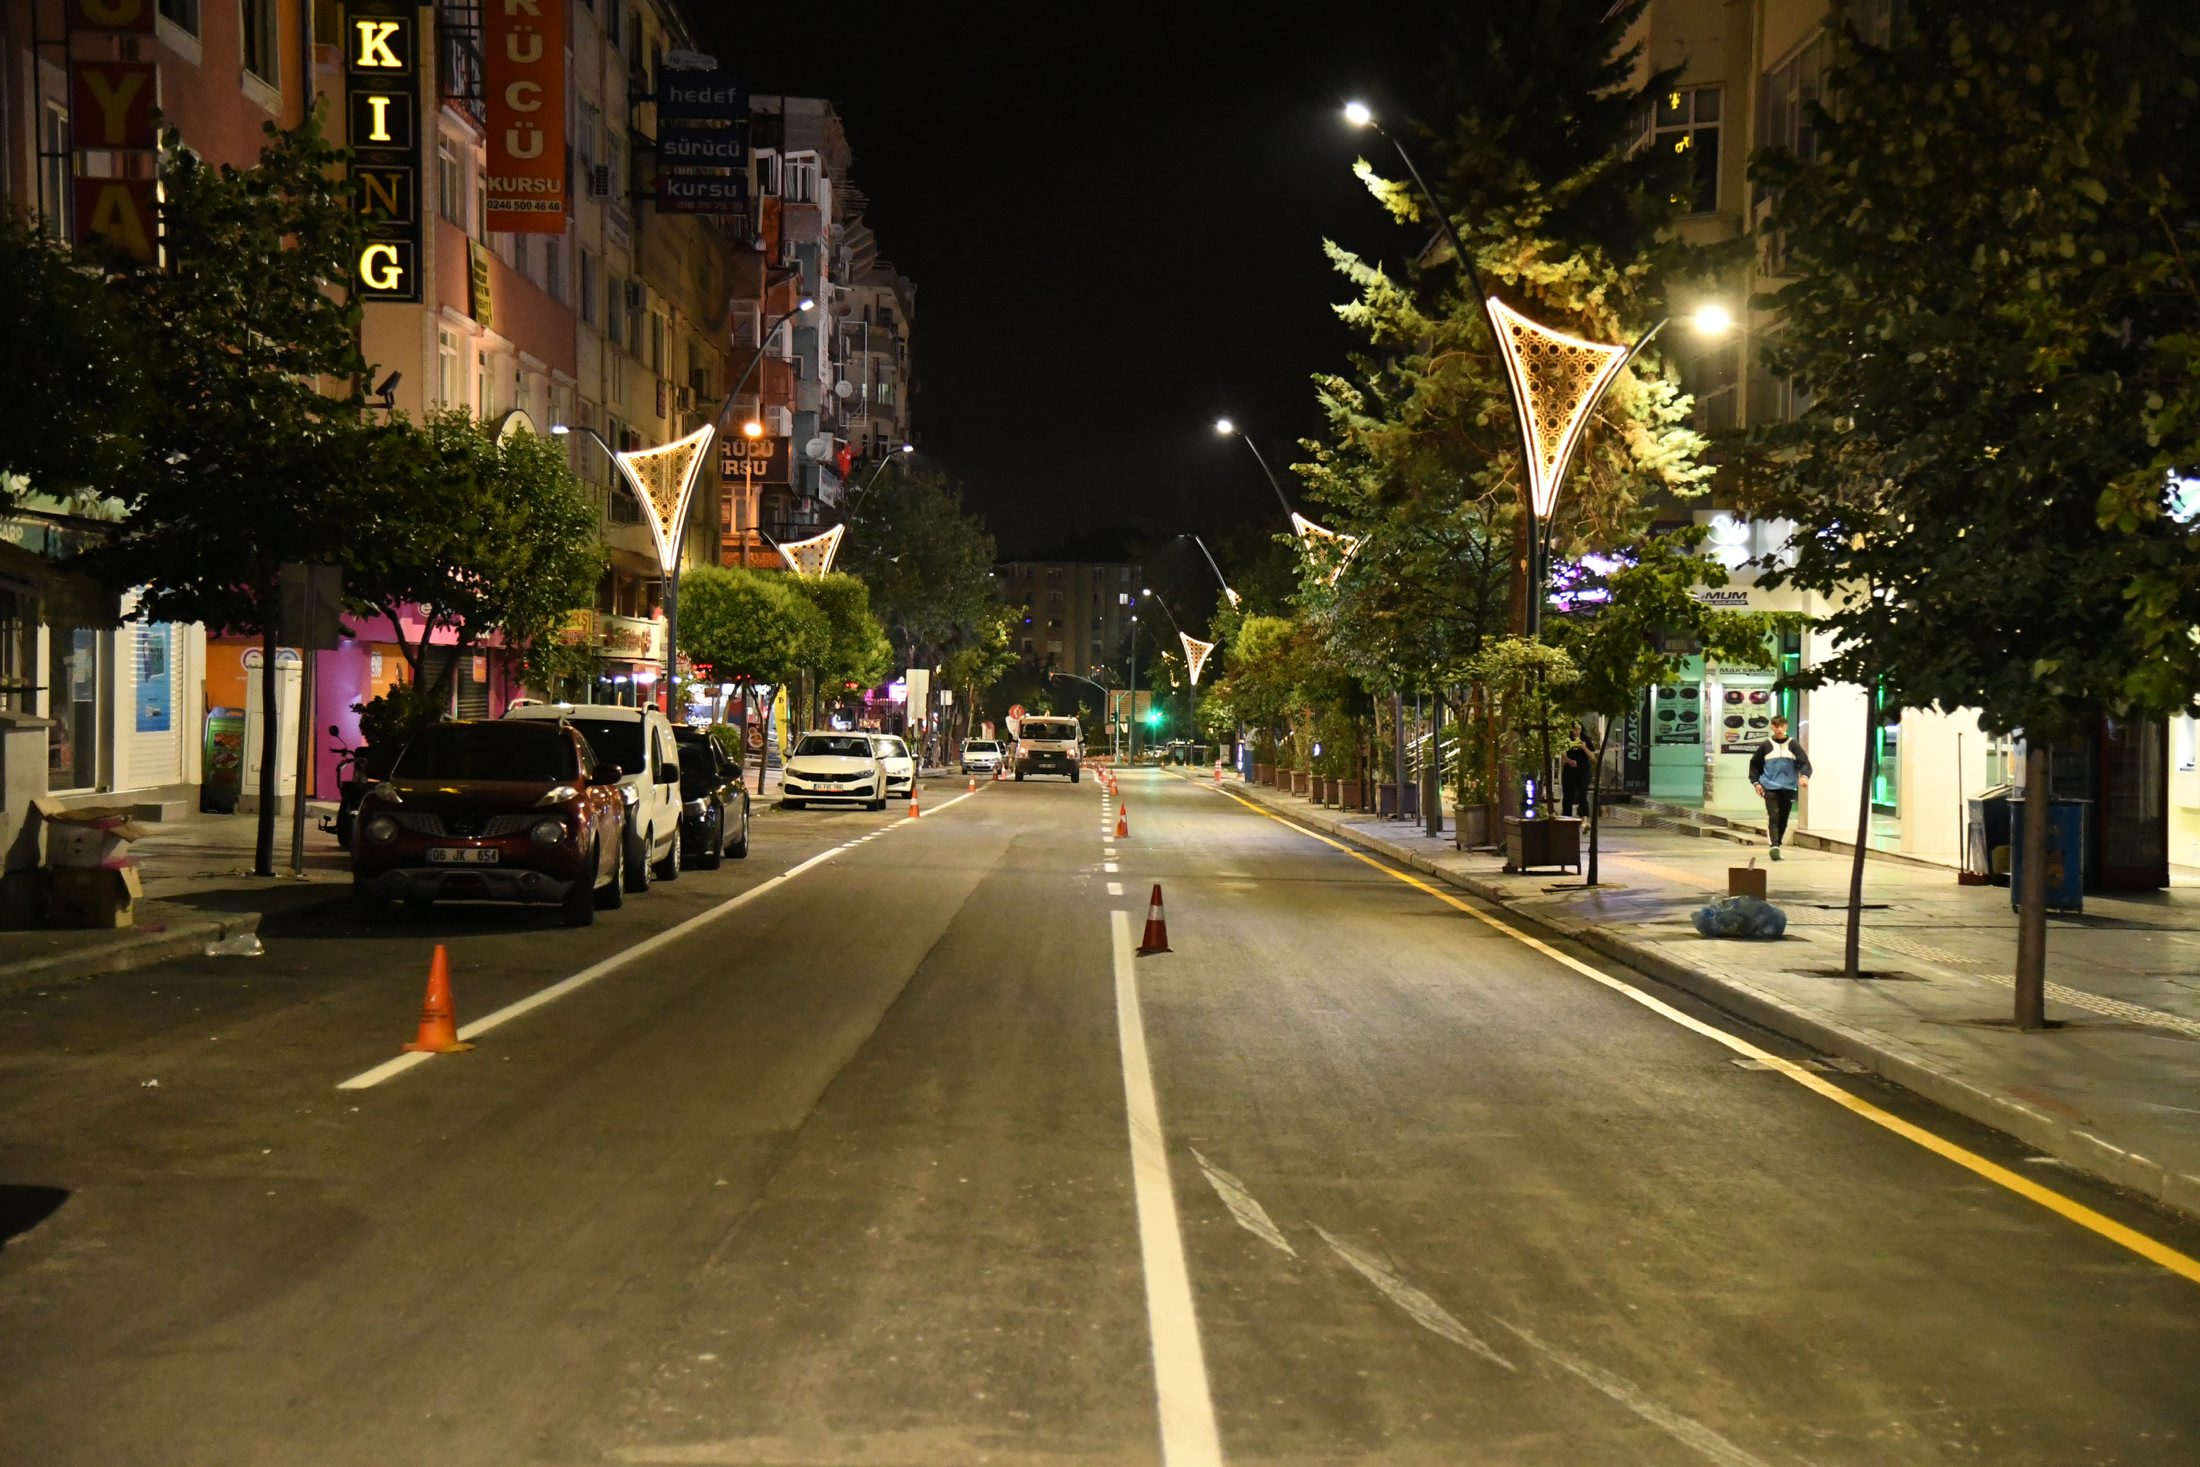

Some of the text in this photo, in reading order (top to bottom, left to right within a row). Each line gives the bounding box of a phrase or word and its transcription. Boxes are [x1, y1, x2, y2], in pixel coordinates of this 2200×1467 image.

[669, 86, 737, 105] hedef
[355, 20, 405, 291] KING
[663, 136, 741, 158] sürücü
[487, 176, 562, 194] KURSU
[666, 178, 738, 198] kursu
[487, 199, 512, 211] 0246
[514, 200, 533, 211] 500
[534, 201, 547, 211] 46
[722, 460, 768, 476] RSU
[433, 849, 497, 862] 06 JK 654
